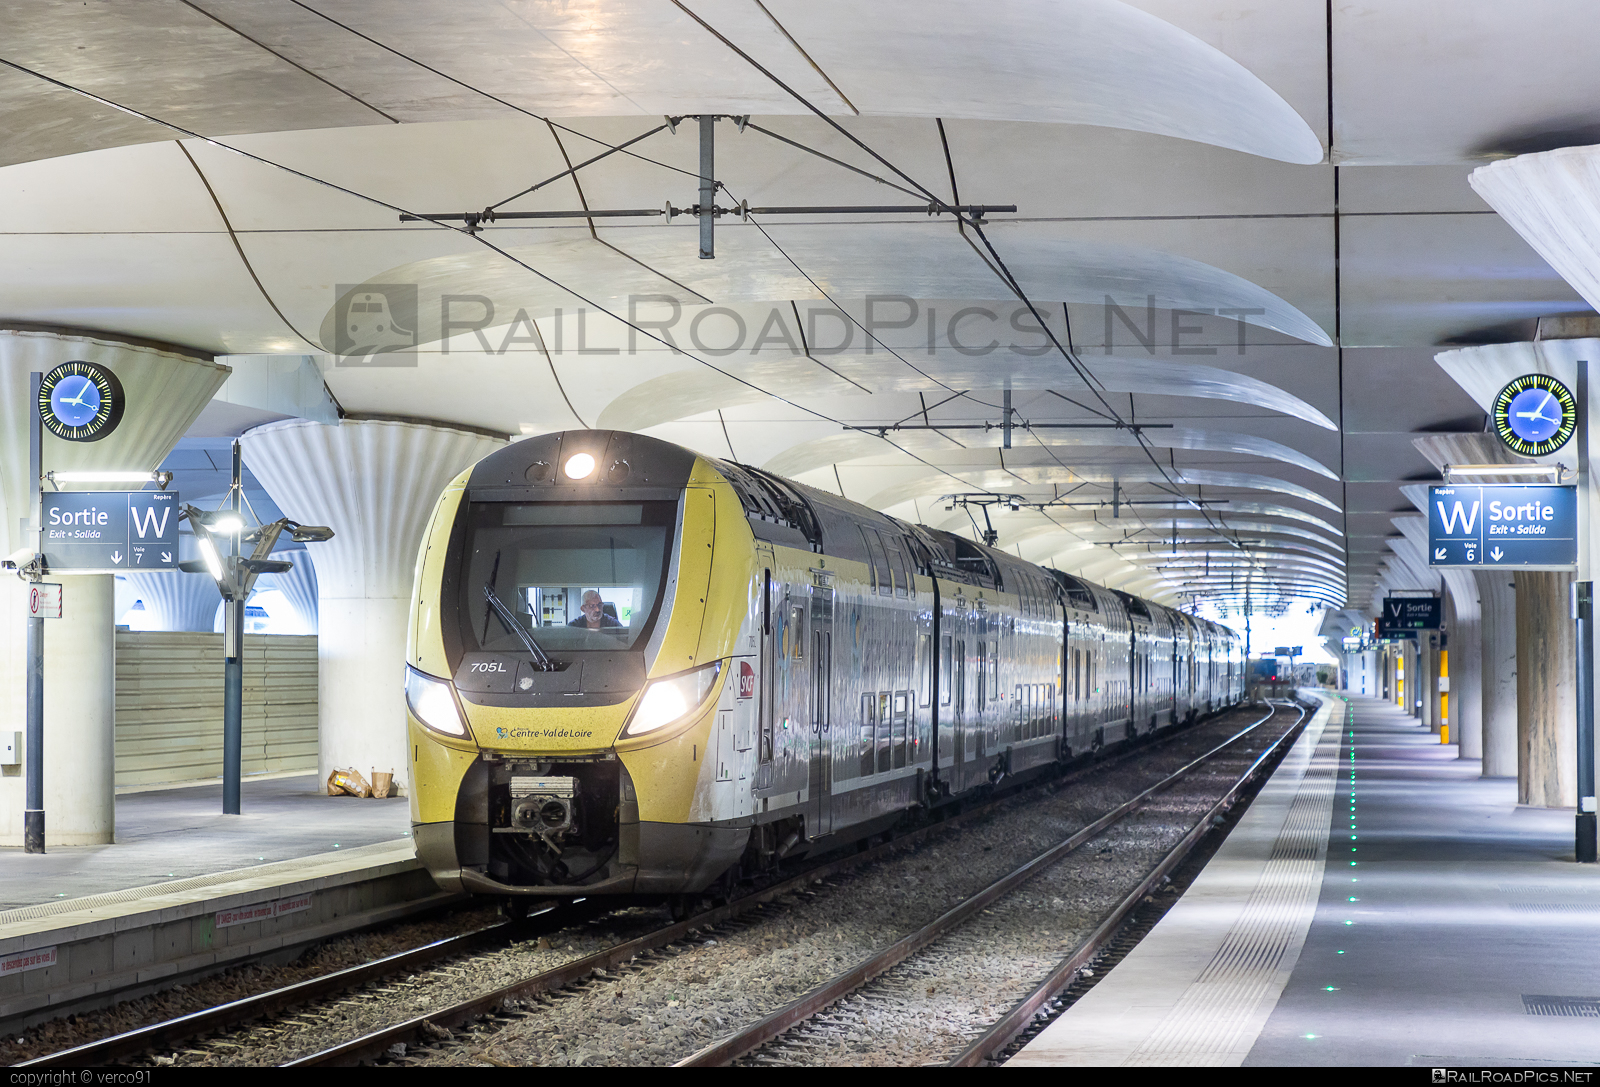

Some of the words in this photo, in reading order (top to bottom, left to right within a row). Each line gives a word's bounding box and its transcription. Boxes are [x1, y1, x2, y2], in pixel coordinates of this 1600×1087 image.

[48, 506, 109, 526] Sortie
[1489, 500, 1554, 521] Sortie
[130, 506, 171, 539] W
[1436, 500, 1480, 535] W
[48, 529, 66, 539] Exit
[73, 529, 101, 539] Salida
[1489, 524, 1509, 535] Exit
[1516, 524, 1547, 535] Salida
[135, 553, 143, 564] 7
[1466, 549, 1475, 562] 6
[1391, 603, 1402, 617] V
[1406, 603, 1433, 612] Sortie
[470, 662, 508, 673] 705L
[740, 675, 754, 693] SNCF
[510, 728, 558, 738] Centre-Val
[569, 728, 593, 738] Loire
